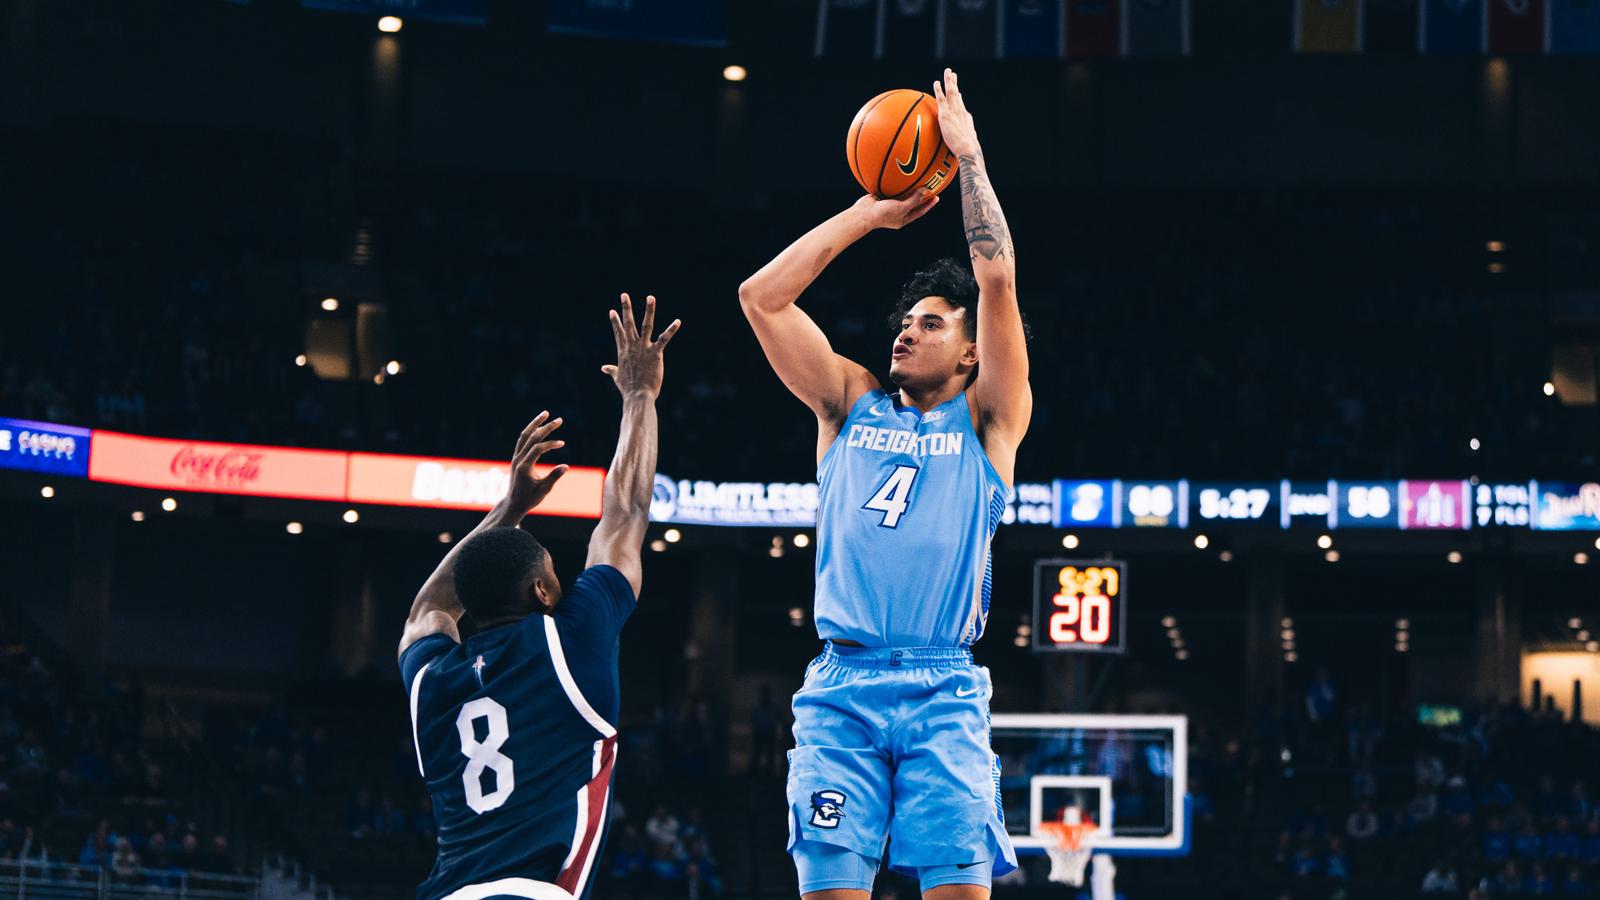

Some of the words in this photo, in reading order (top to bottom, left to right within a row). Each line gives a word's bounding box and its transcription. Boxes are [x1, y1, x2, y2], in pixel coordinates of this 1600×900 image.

[925, 150, 956, 191] ELIT
[847, 424, 963, 457] CREIGHTON
[678, 480, 819, 511] LIMITLESS
[861, 464, 920, 529] 4
[1200, 488, 1270, 519] 5:27
[1059, 566, 1119, 597] 5:27
[1049, 593, 1111, 643] 20
[455, 697, 515, 815] 8
